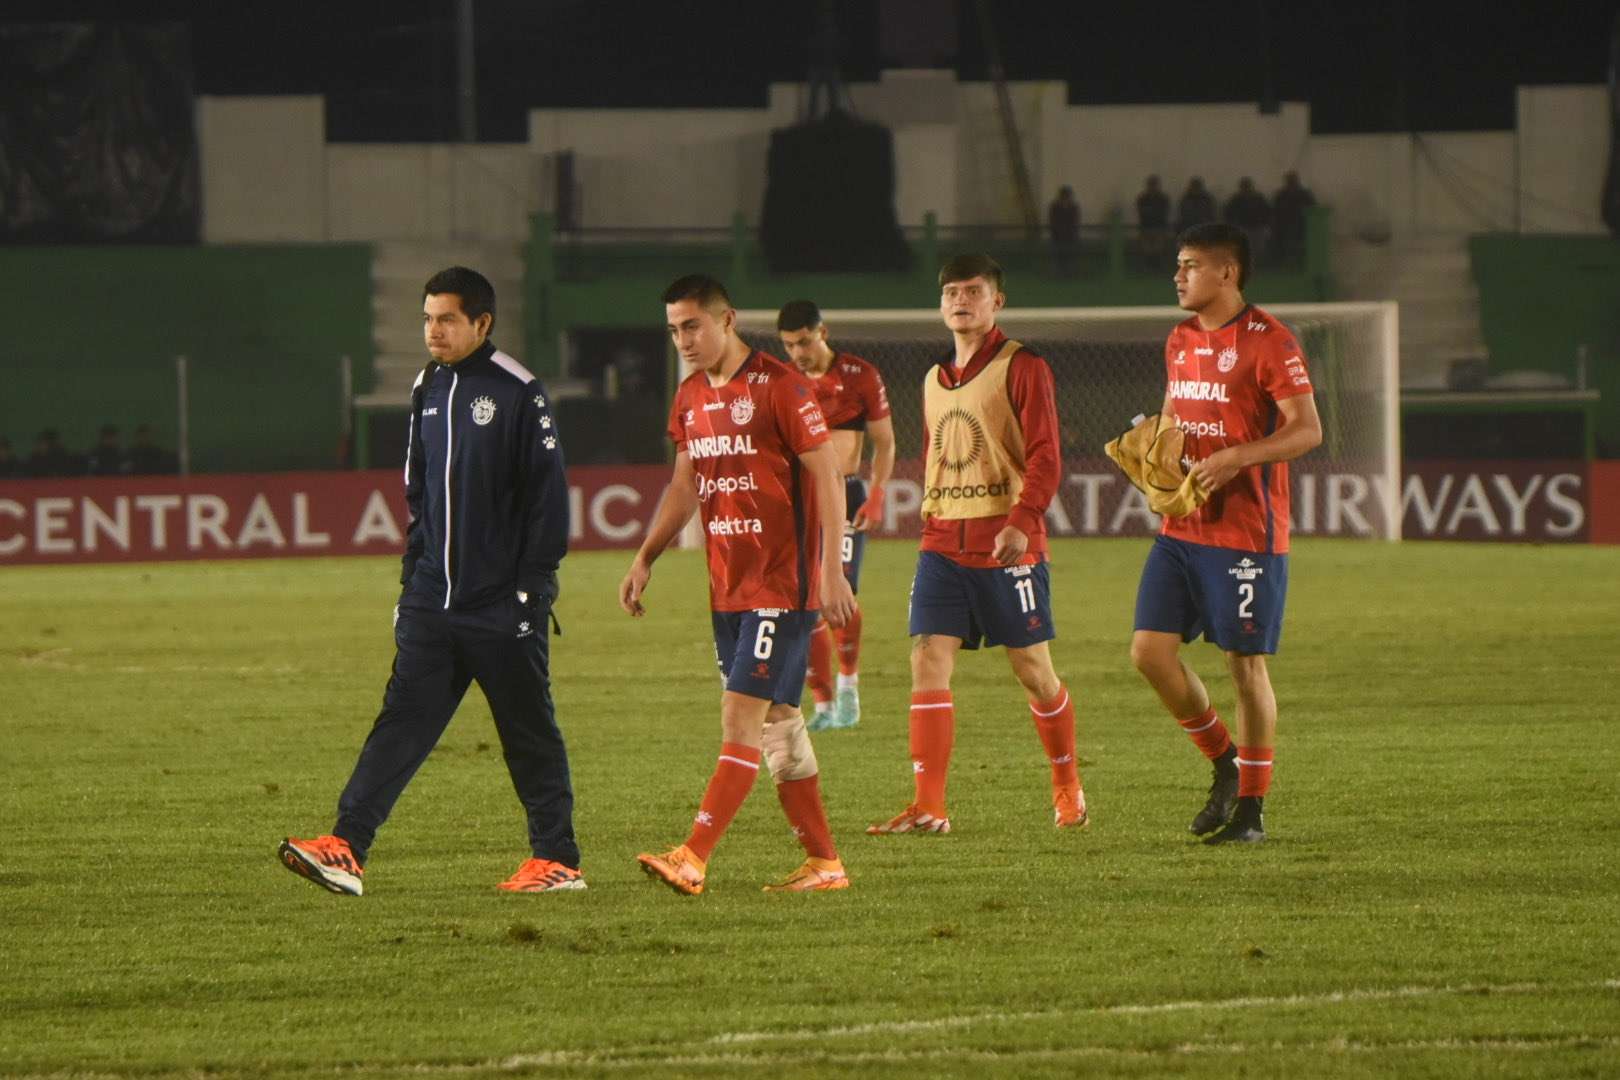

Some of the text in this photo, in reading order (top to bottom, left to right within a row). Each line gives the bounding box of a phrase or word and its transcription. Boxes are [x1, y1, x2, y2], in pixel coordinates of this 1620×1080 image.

[1170, 380, 1231, 403] ANRURAL
[686, 434, 758, 461] ANRURAL
[706, 471, 758, 499] pepsi
[923, 477, 1011, 501] oncacaf
[1289, 473, 1585, 537] IRWAYS
[708, 515, 763, 536] elektra
[1014, 578, 1036, 613] 11
[1238, 583, 1254, 618] 2
[753, 620, 776, 660] 6
